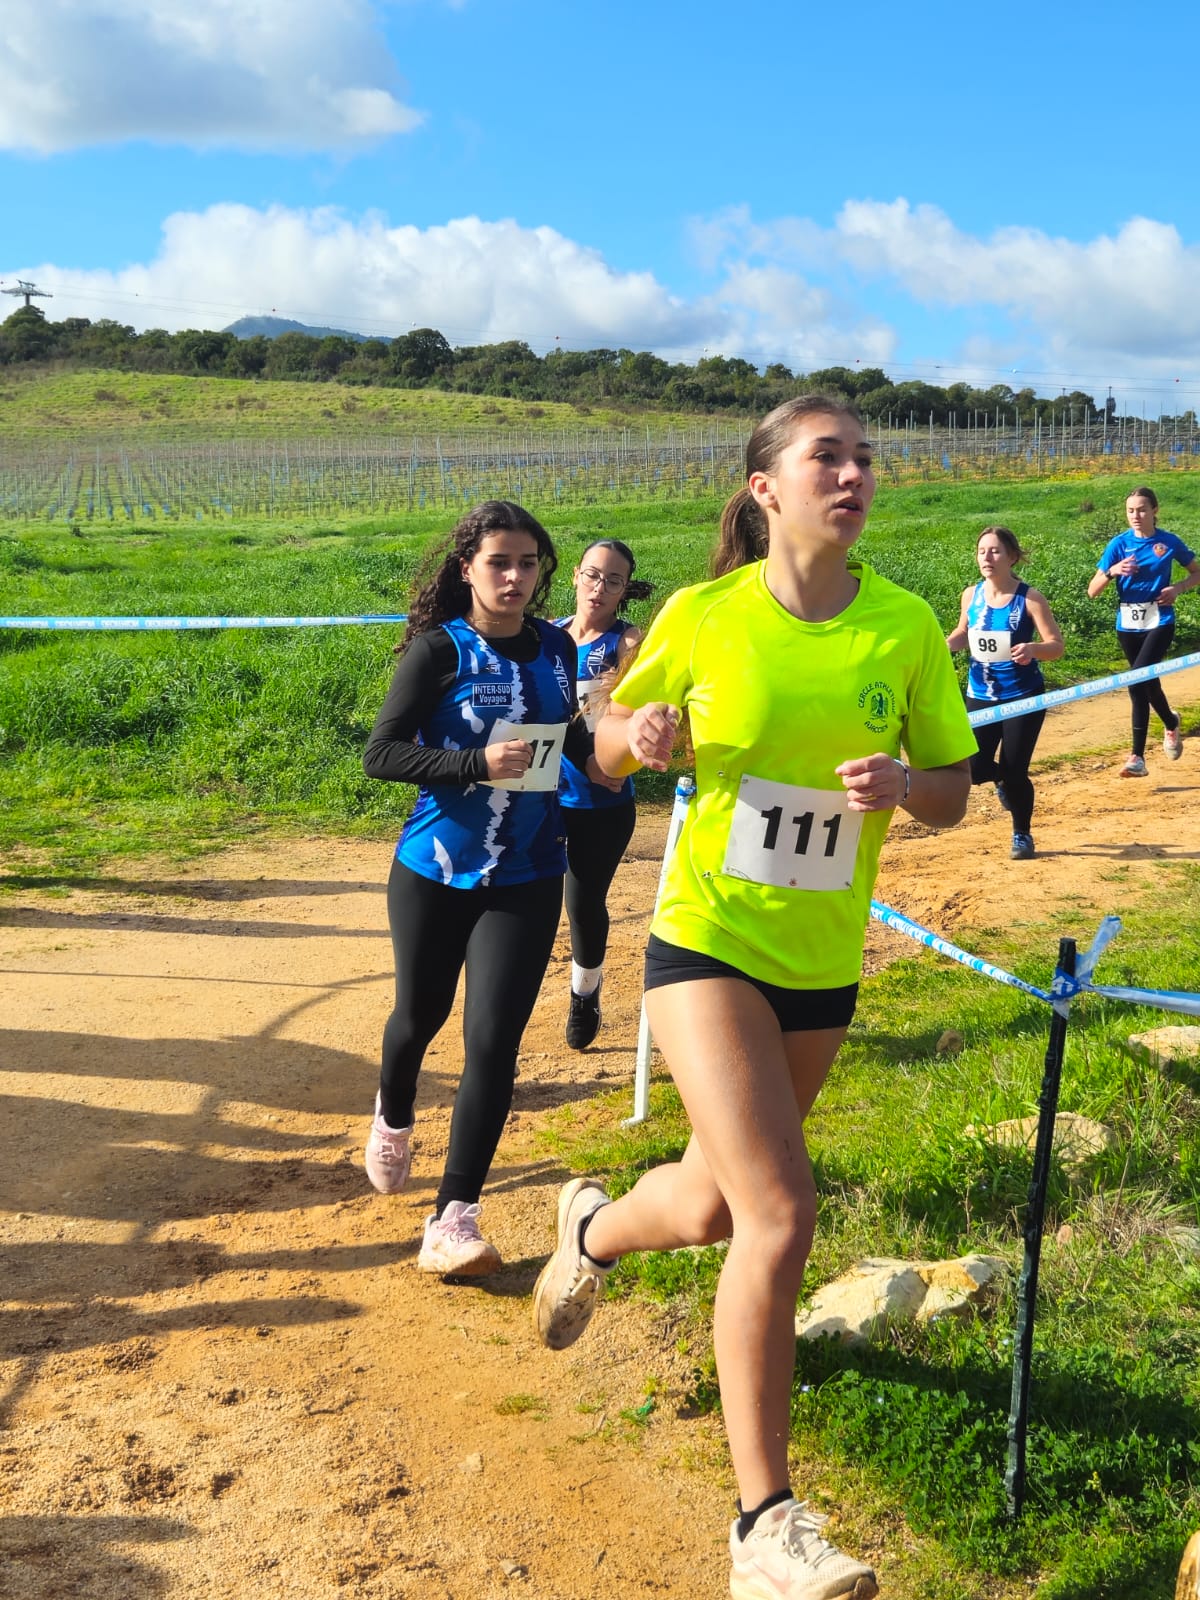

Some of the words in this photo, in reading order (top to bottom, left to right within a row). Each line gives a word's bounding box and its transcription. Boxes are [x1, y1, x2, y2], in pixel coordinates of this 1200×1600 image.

[1132, 609, 1147, 621] 87
[978, 638, 997, 653] 98
[475, 685, 510, 694] INTER-SUD
[479, 694, 507, 704] Voyages
[508, 739, 555, 769] 17
[761, 806, 841, 857] 111
